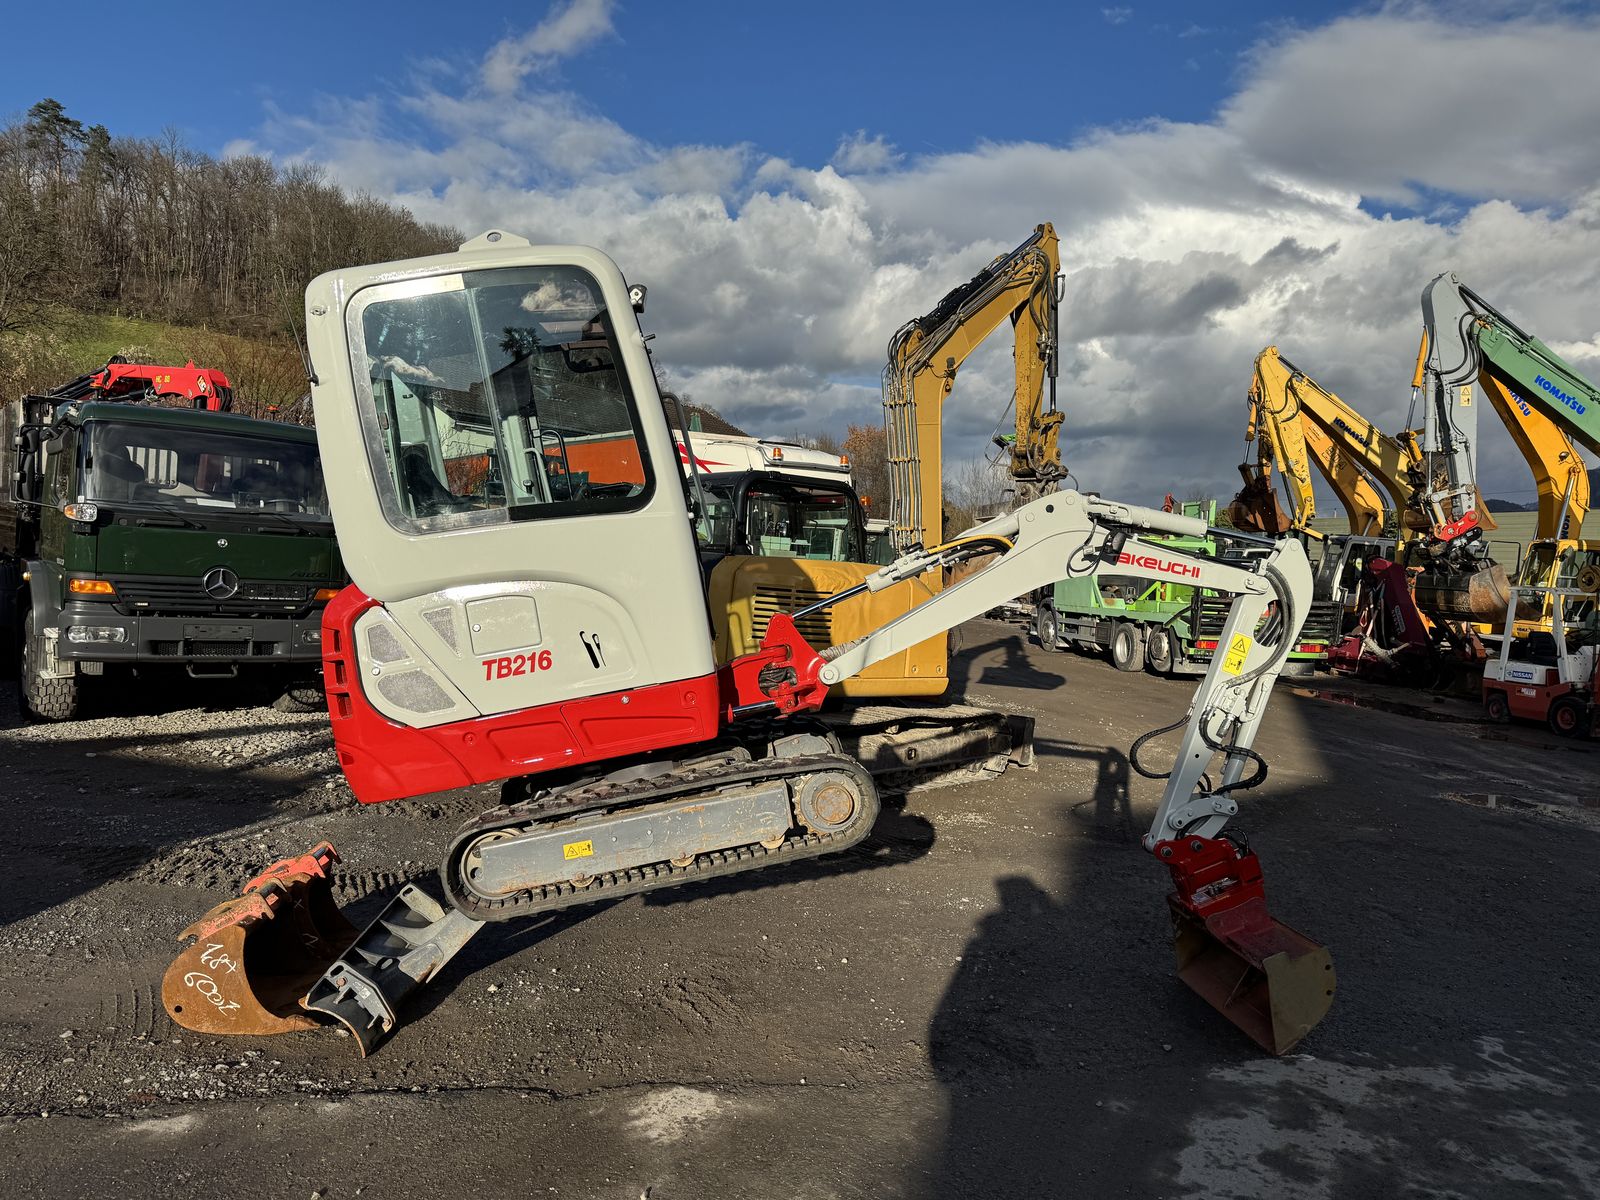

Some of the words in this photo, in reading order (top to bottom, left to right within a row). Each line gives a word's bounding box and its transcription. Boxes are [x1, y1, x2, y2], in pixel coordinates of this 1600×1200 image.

[1534, 374, 1586, 415] KOMATSU
[1333, 416, 1370, 448] KOMATSU
[482, 649, 552, 681] TB216
[1513, 671, 1533, 679] NISSAN
